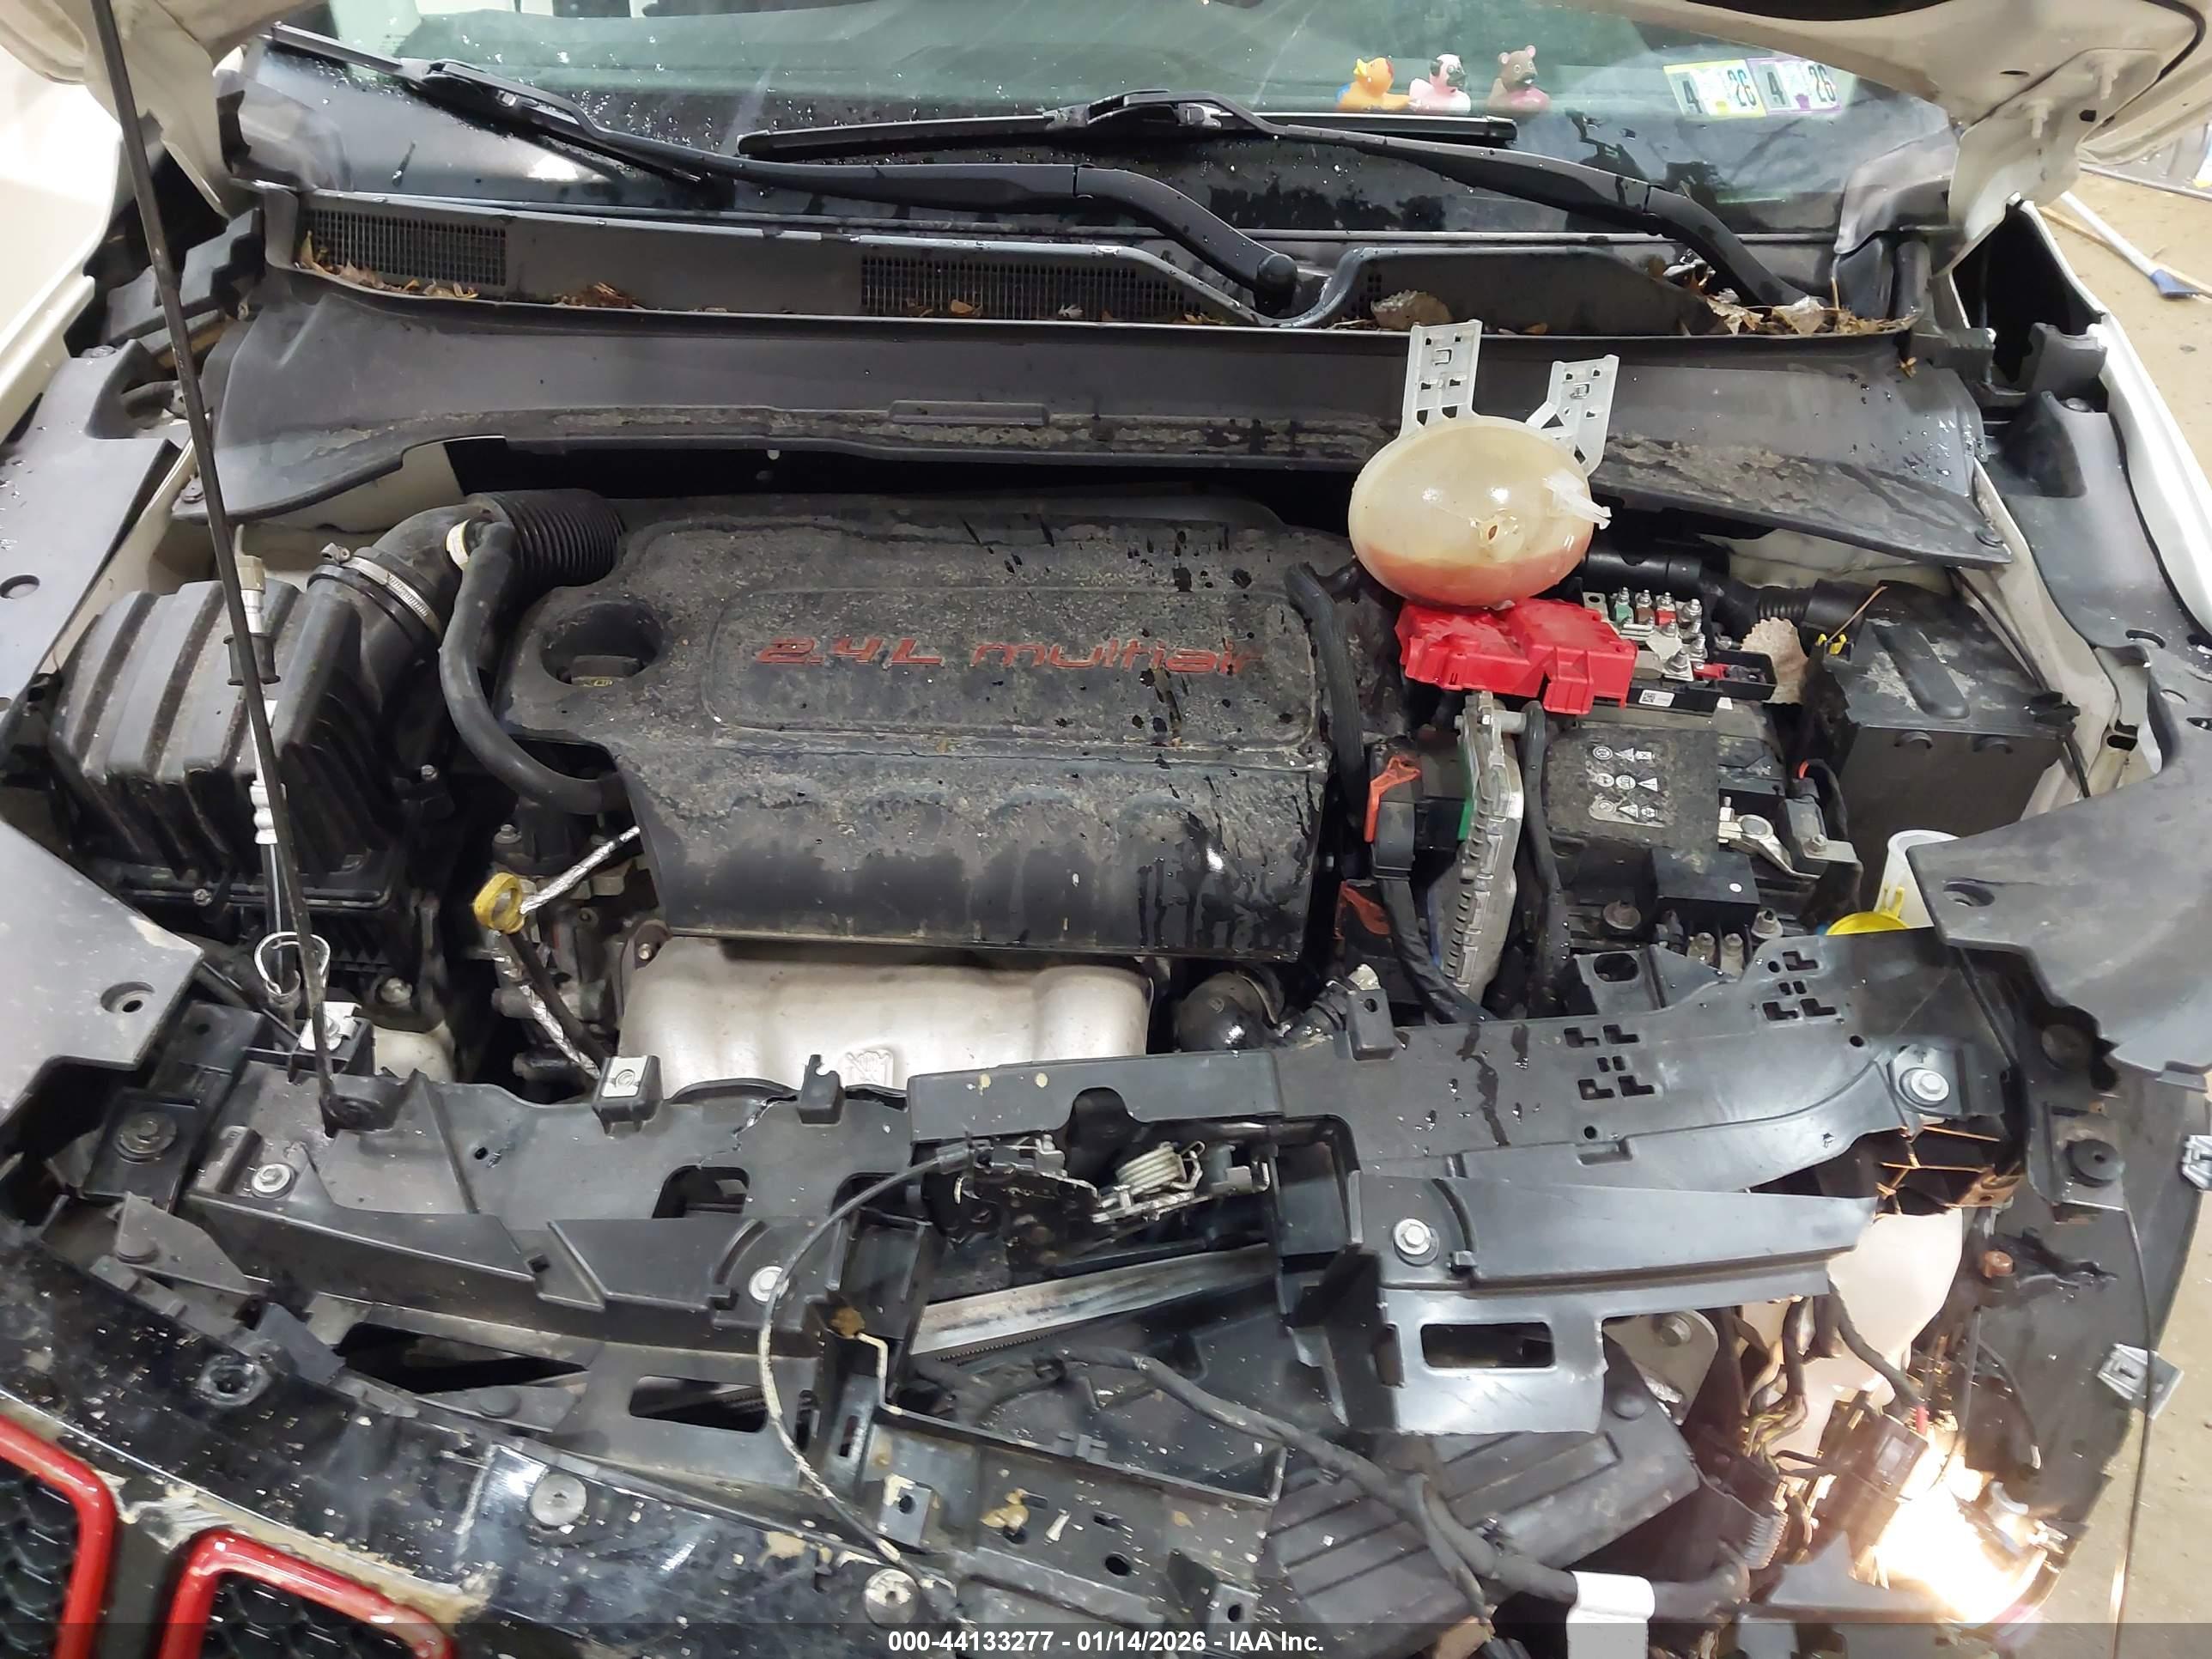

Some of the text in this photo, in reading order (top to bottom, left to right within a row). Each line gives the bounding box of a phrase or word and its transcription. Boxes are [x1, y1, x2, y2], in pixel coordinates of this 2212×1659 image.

[1682, 69, 1757, 114] 4 26
[1766, 64, 1836, 105] 4 26
[756, 638, 1264, 674] 2.4L multiair
